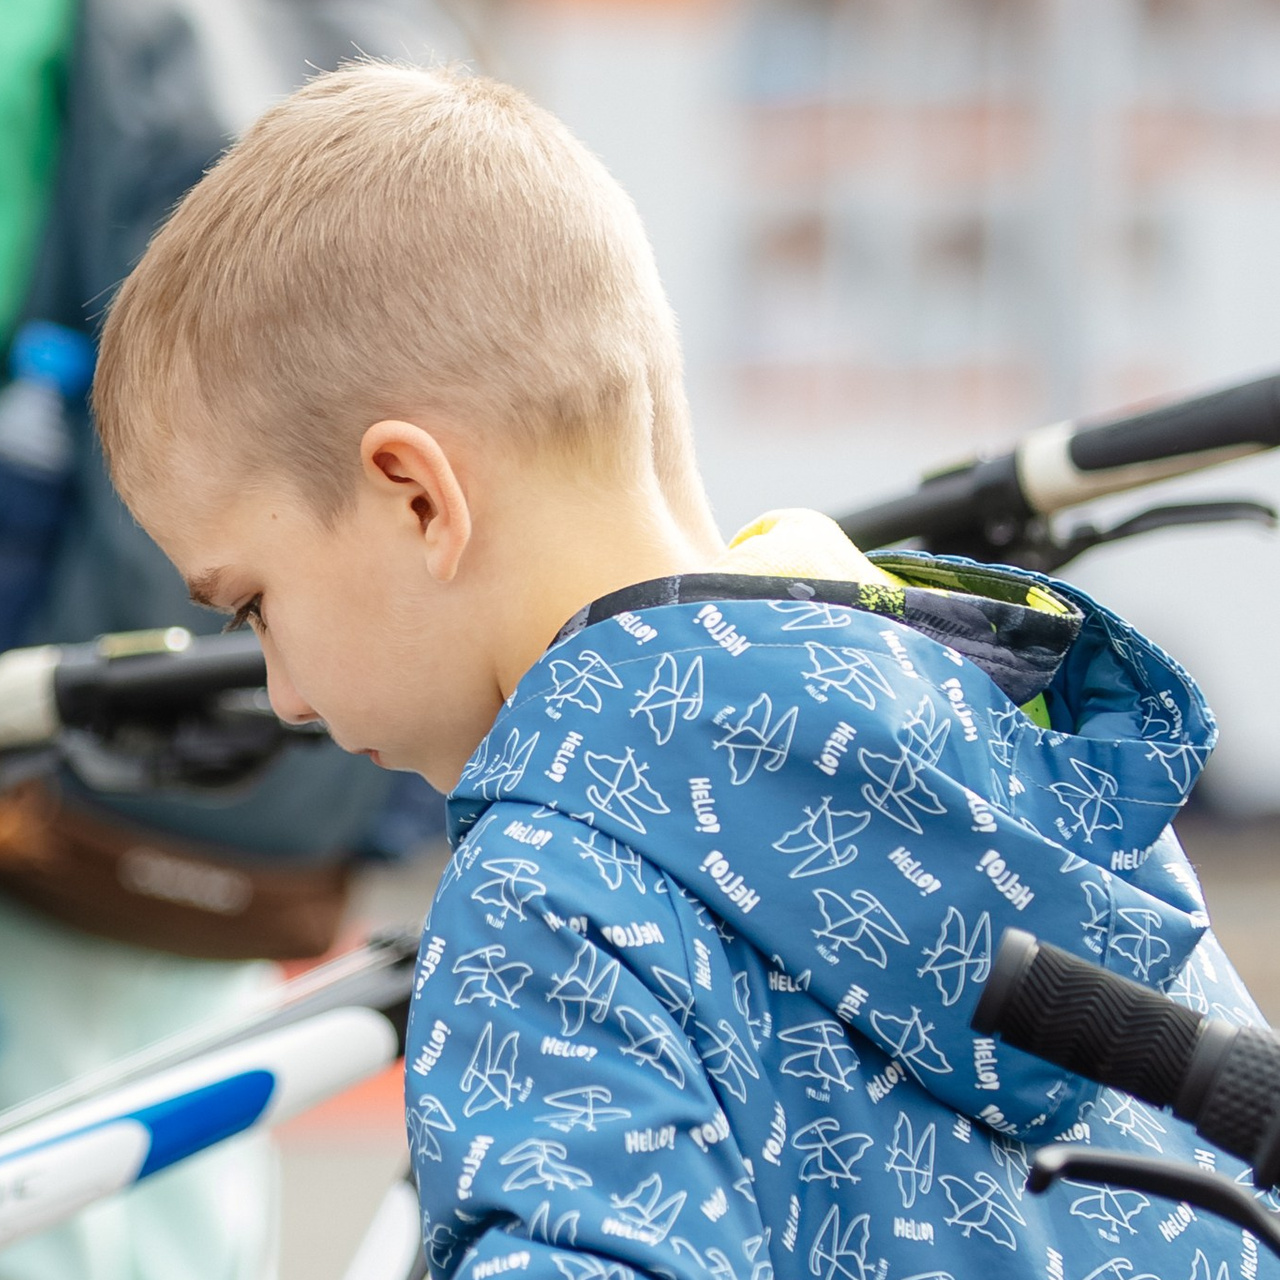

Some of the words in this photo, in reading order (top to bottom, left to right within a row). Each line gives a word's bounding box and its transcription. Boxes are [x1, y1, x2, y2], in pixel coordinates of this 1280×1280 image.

[693, 604, 751, 656] HELLO!
[880, 629, 918, 678] HELLO!
[940, 678, 977, 742] HELLO!
[544, 731, 583, 782] HELLO!
[813, 721, 857, 776] HELLO!
[689, 777, 720, 833] HELLO!
[503, 821, 553, 850] HELLO!
[699, 850, 760, 913] HELLO!
[888, 846, 942, 897] HELLO!
[975, 849, 1035, 911] HELLO!
[413, 1020, 452, 1076] HELLO!
[973, 1037, 1000, 1090] HELLO!
[865, 1060, 905, 1105] HELLO!
[625, 1125, 675, 1153] HELLO!
[457, 1135, 494, 1200] HELLO!
[893, 1217, 935, 1245] HELLO!
[1158, 1201, 1198, 1243] HELLO!
